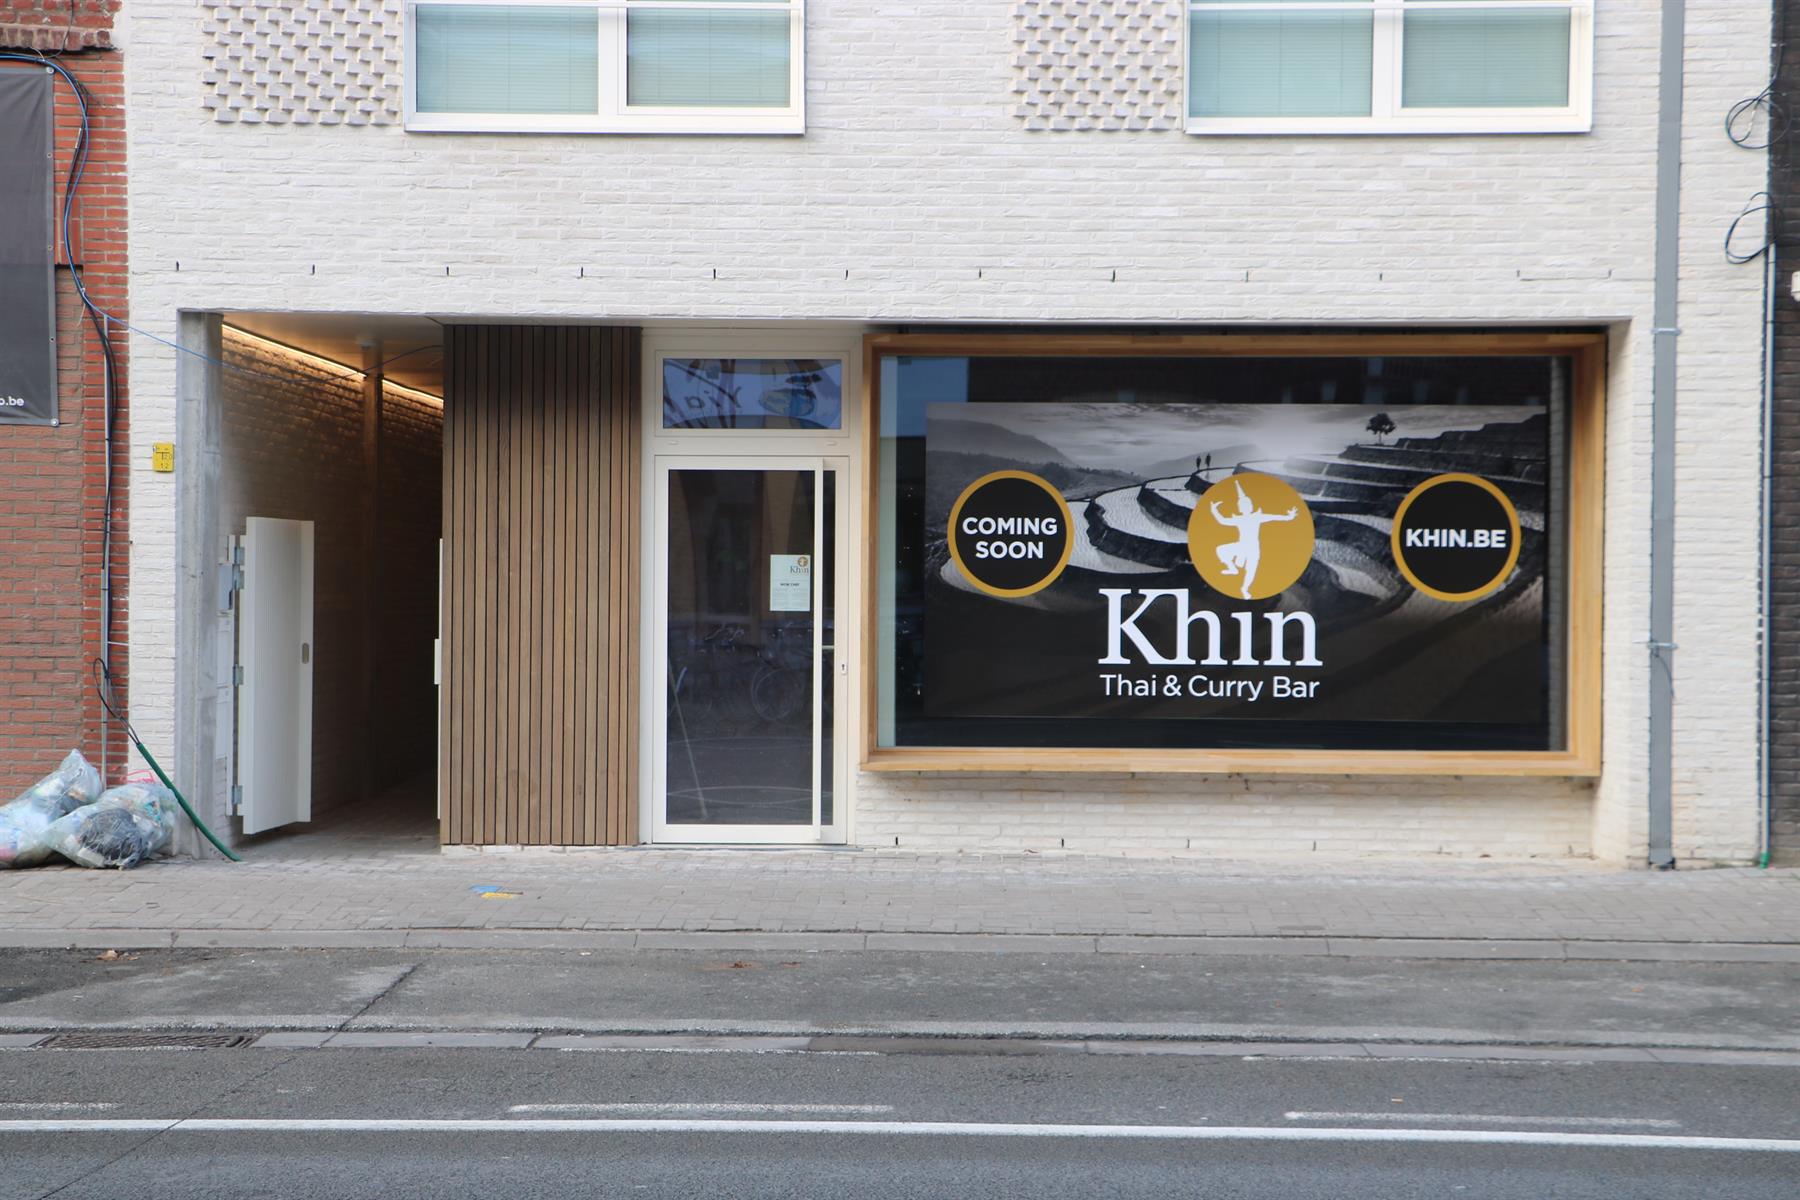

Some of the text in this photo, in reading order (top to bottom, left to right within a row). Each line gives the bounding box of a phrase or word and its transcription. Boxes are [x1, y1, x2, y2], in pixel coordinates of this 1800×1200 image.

[962, 516, 1058, 536] COMING
[1406, 529, 1507, 549] KHIN.BE
[975, 540, 1044, 560] SOON
[1097, 588, 1323, 667] Khin
[1099, 674, 1321, 702] Thai & Curry Bar
